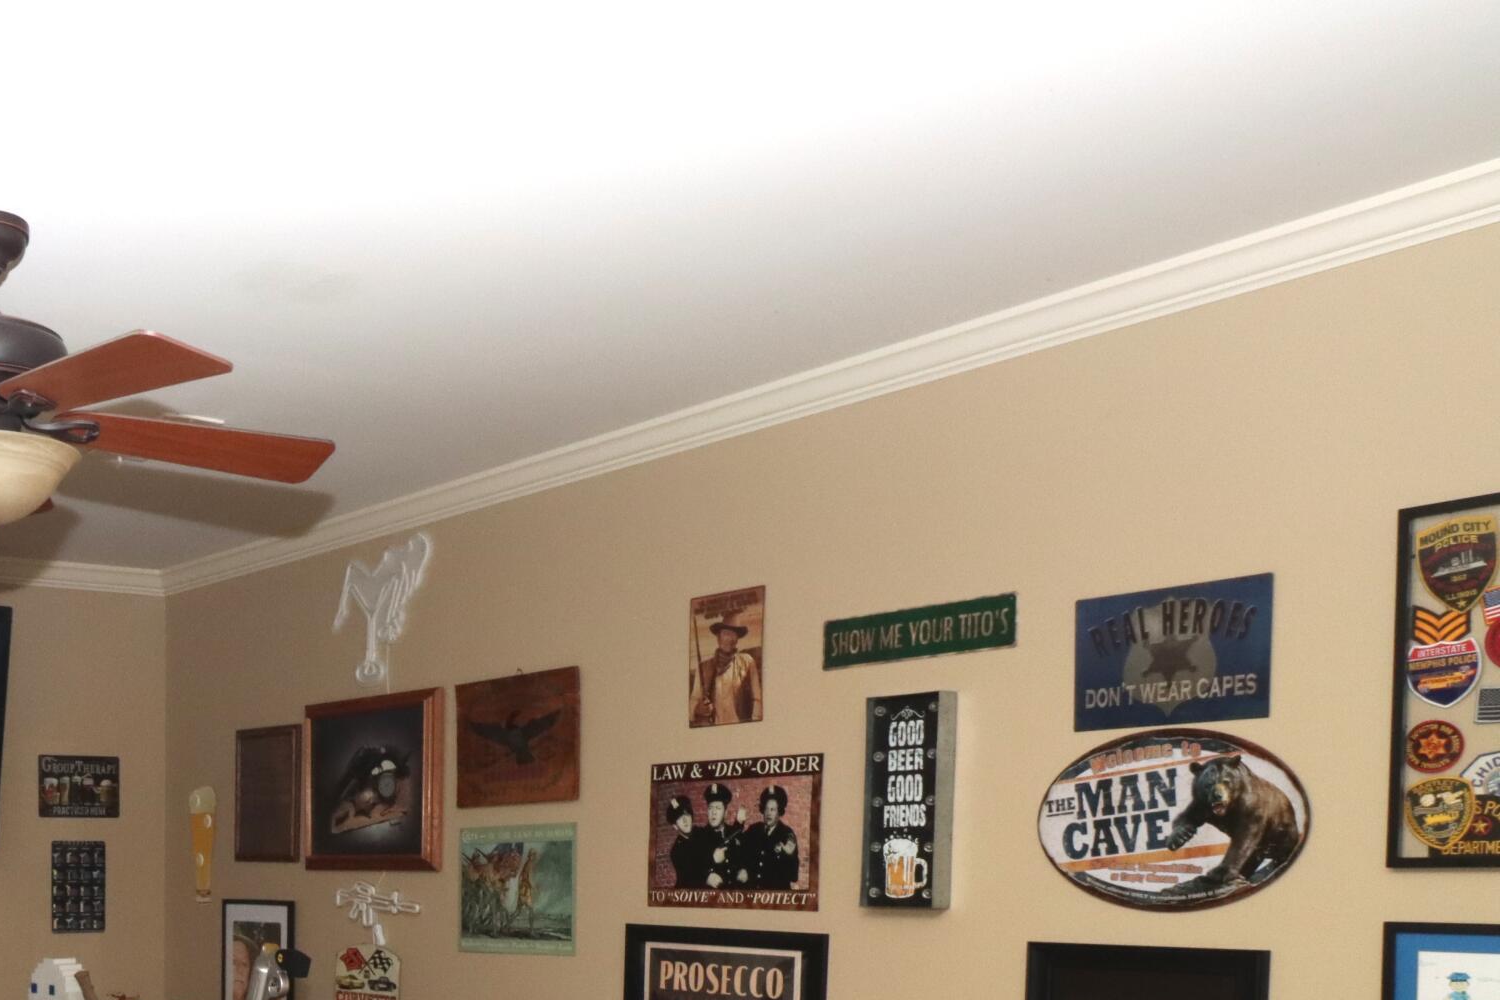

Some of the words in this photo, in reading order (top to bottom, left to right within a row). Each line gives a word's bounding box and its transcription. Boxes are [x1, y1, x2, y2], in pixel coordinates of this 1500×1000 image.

[1462, 519, 1492, 533] CITY
[1435, 534, 1479, 552] POLICE
[831, 627, 876, 657] SHOW
[879, 623, 903, 649] ME
[909, 616, 954, 646] YOUR
[958, 607, 1010, 640] TITO'S
[1087, 606, 1150, 657] REAL
[1161, 598, 1259, 641] HEROES
[1417, 644, 1467, 658] INTERSTATE
[1085, 682, 1136, 709] DON'T
[1139, 679, 1193, 705] WEAR
[1196, 673, 1258, 699] CAPES
[888, 719, 925, 747] GOOD
[653, 764, 686, 781] LAW
[690, 763, 703, 779] &
[887, 748, 924, 772] BEER
[887, 774, 923, 802] GOOD
[1075, 767, 1177, 820] MAN
[883, 804, 927, 828] FRIENDS
[1045, 797, 1076, 813] THE
[1062, 810, 1171, 860] CAVE
[651, 890, 665, 902] TO
[717, 892, 744, 904] AND
[659, 960, 784, 999] PROSECCO
